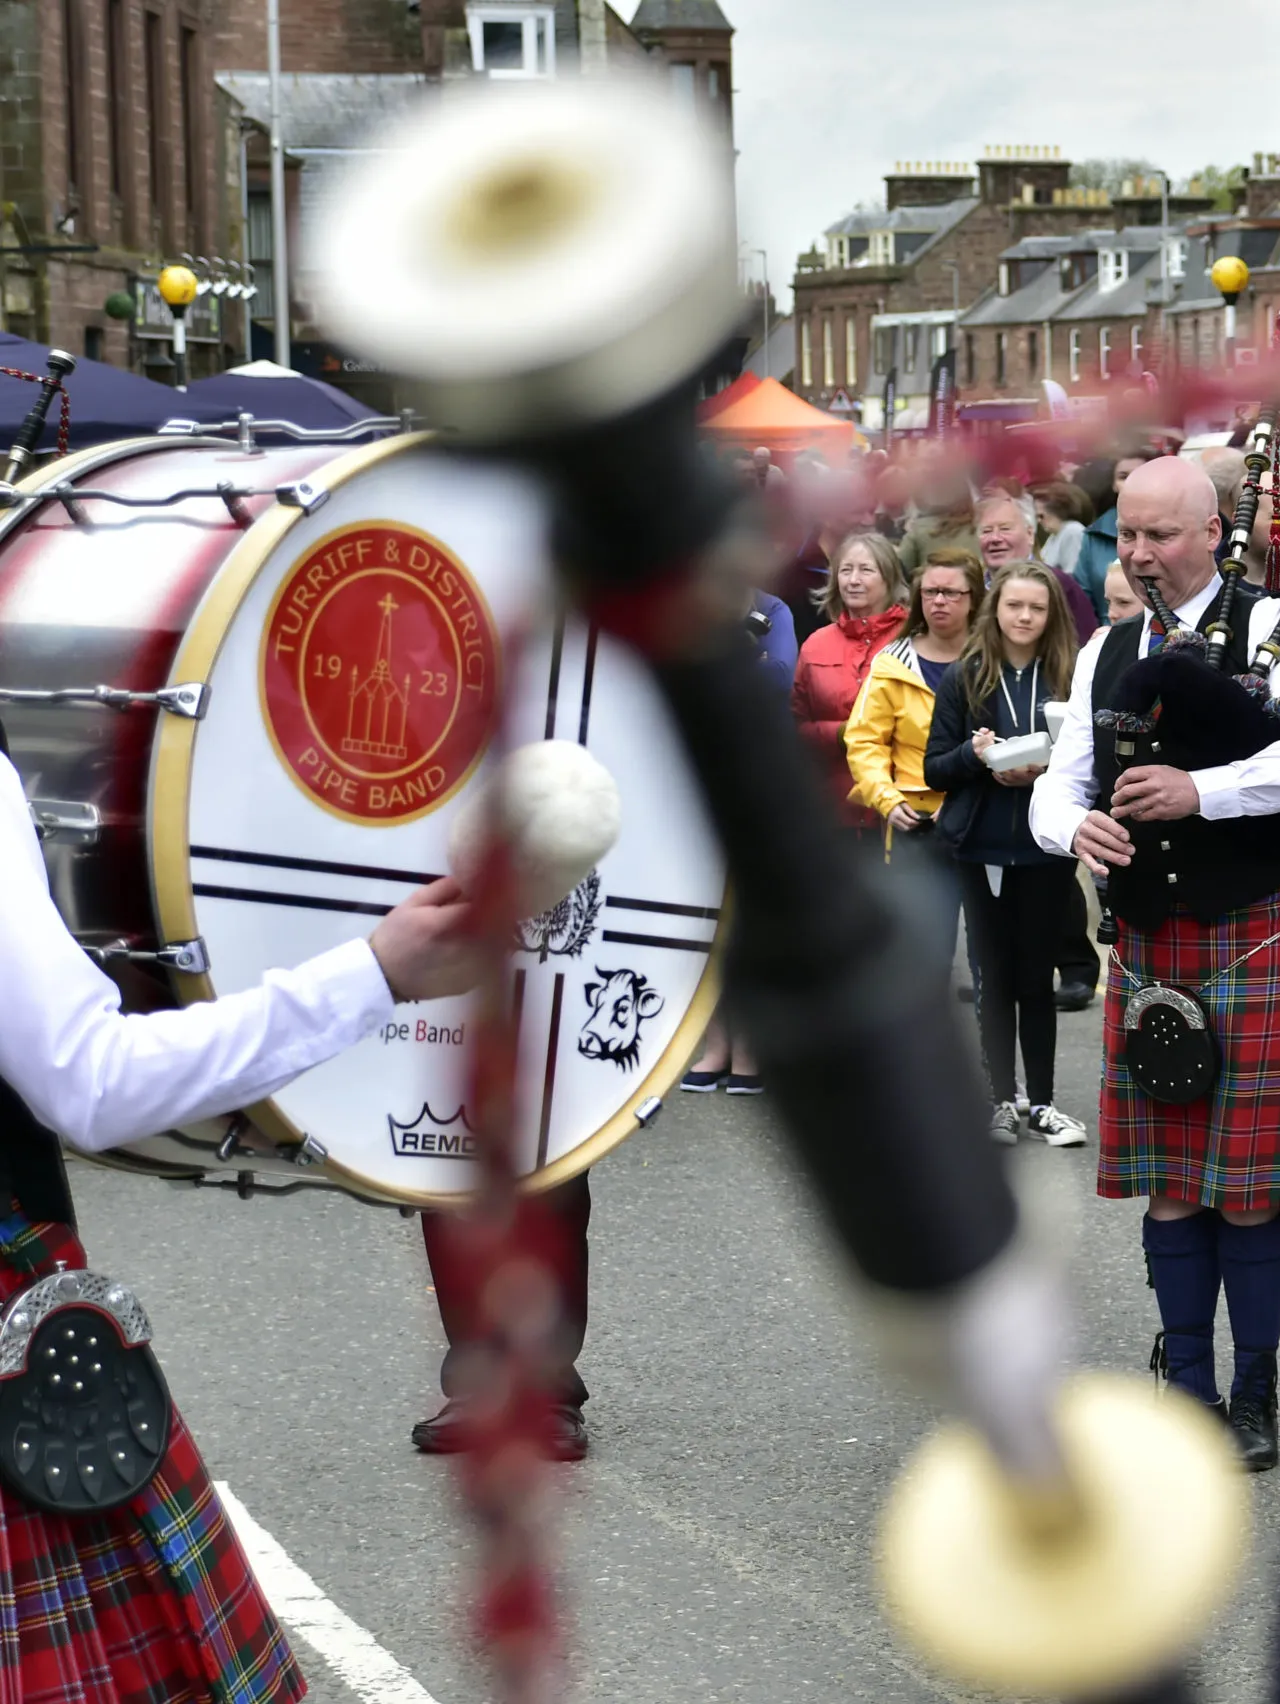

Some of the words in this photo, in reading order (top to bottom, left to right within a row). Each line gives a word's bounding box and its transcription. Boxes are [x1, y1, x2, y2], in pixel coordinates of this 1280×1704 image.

[275, 539, 373, 661] TURRIFF
[384, 538, 401, 563] &
[408, 545, 485, 700] DISTRICT
[313, 654, 342, 679] 19
[420, 670, 448, 696] 23
[298, 747, 359, 805] PIPE
[368, 765, 447, 810] BAND
[415, 1019, 465, 1045] Band
